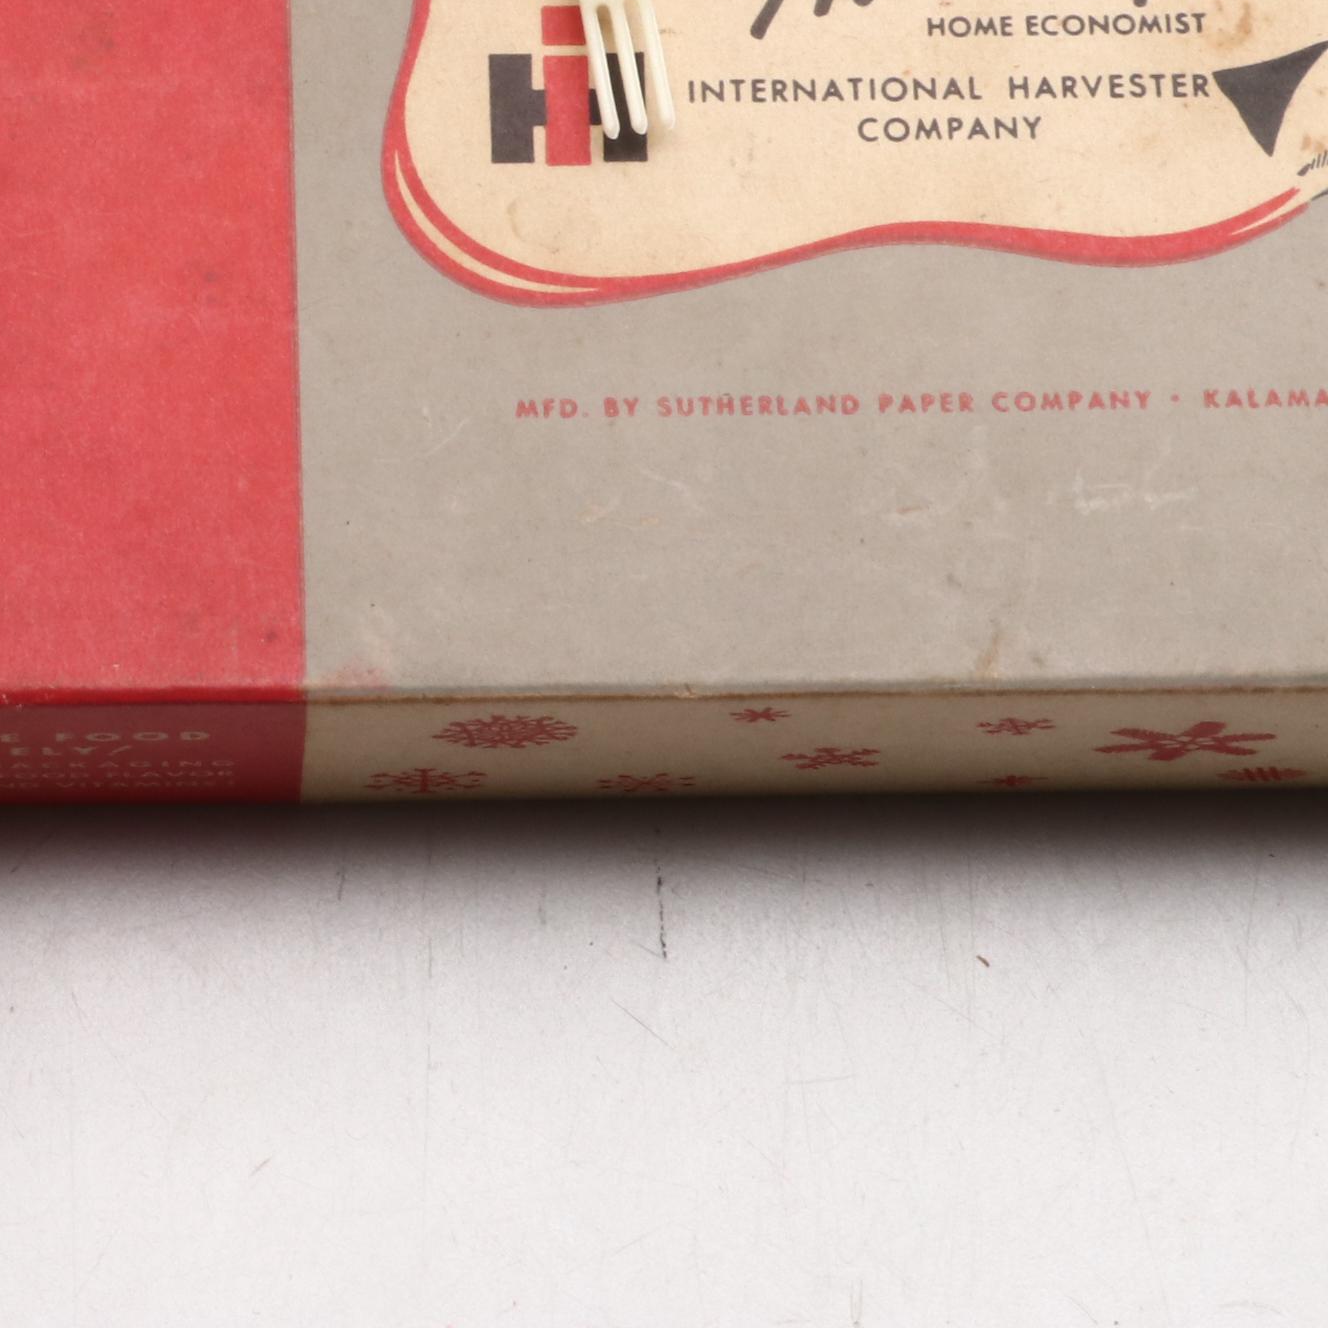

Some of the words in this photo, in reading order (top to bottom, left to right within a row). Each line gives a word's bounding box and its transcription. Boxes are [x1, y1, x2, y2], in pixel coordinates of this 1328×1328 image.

[926, 14, 1010, 38] HOME
[1024, 12, 1207, 37] ECONOMIST
[686, 76, 983, 104] INTERNATIONAL
[1008, 73, 1212, 100] HARVESTER
[856, 114, 1043, 144] COMPANY
[515, 396, 589, 420] MFD.
[603, 396, 639, 418] BY
[657, 394, 859, 418] SUTHERLAND
[878, 391, 974, 415] PAPER
[991, 389, 1152, 413] COMPANY
[1203, 387, 1328, 410] KALAMA
[55, 730, 211, 744] FOOD
